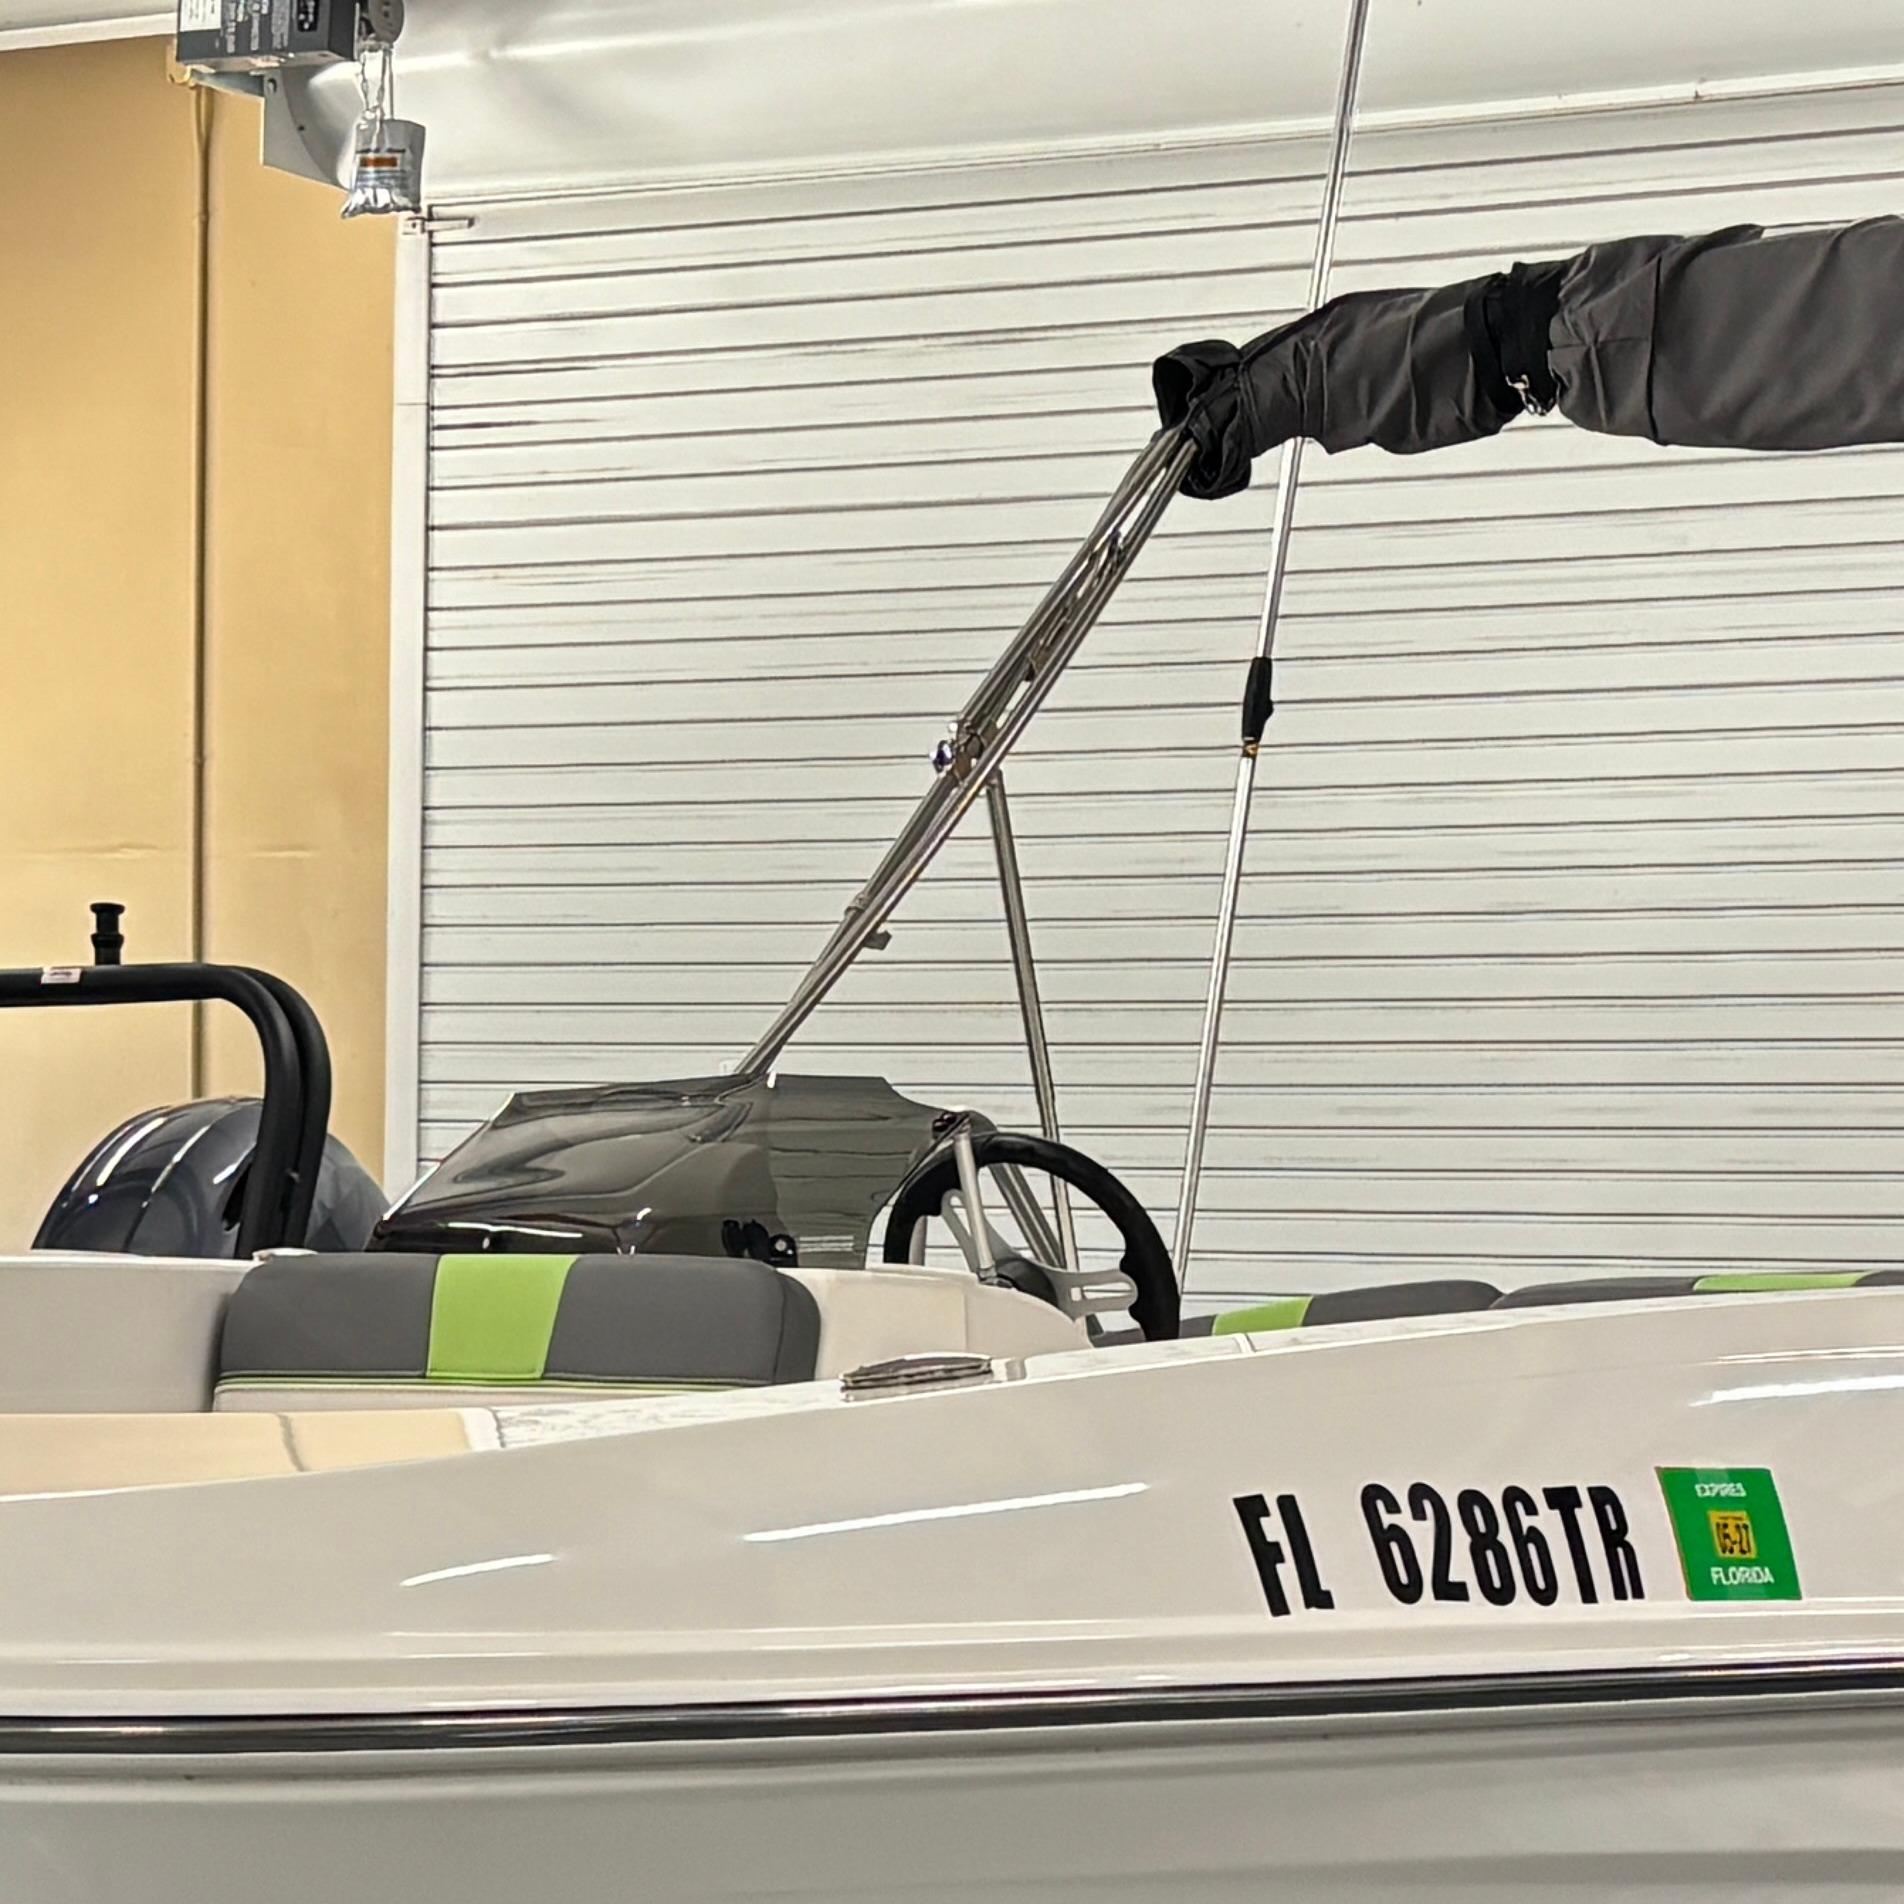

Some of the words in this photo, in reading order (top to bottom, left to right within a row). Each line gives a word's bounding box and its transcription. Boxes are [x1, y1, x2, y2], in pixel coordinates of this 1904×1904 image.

[1694, 1482, 1747, 1498] EXPIRES
[1233, 1494, 1334, 1617] FL
[1360, 1482, 1644, 1606] 6286TR
[1710, 1566, 1775, 1585] FLORIDA
